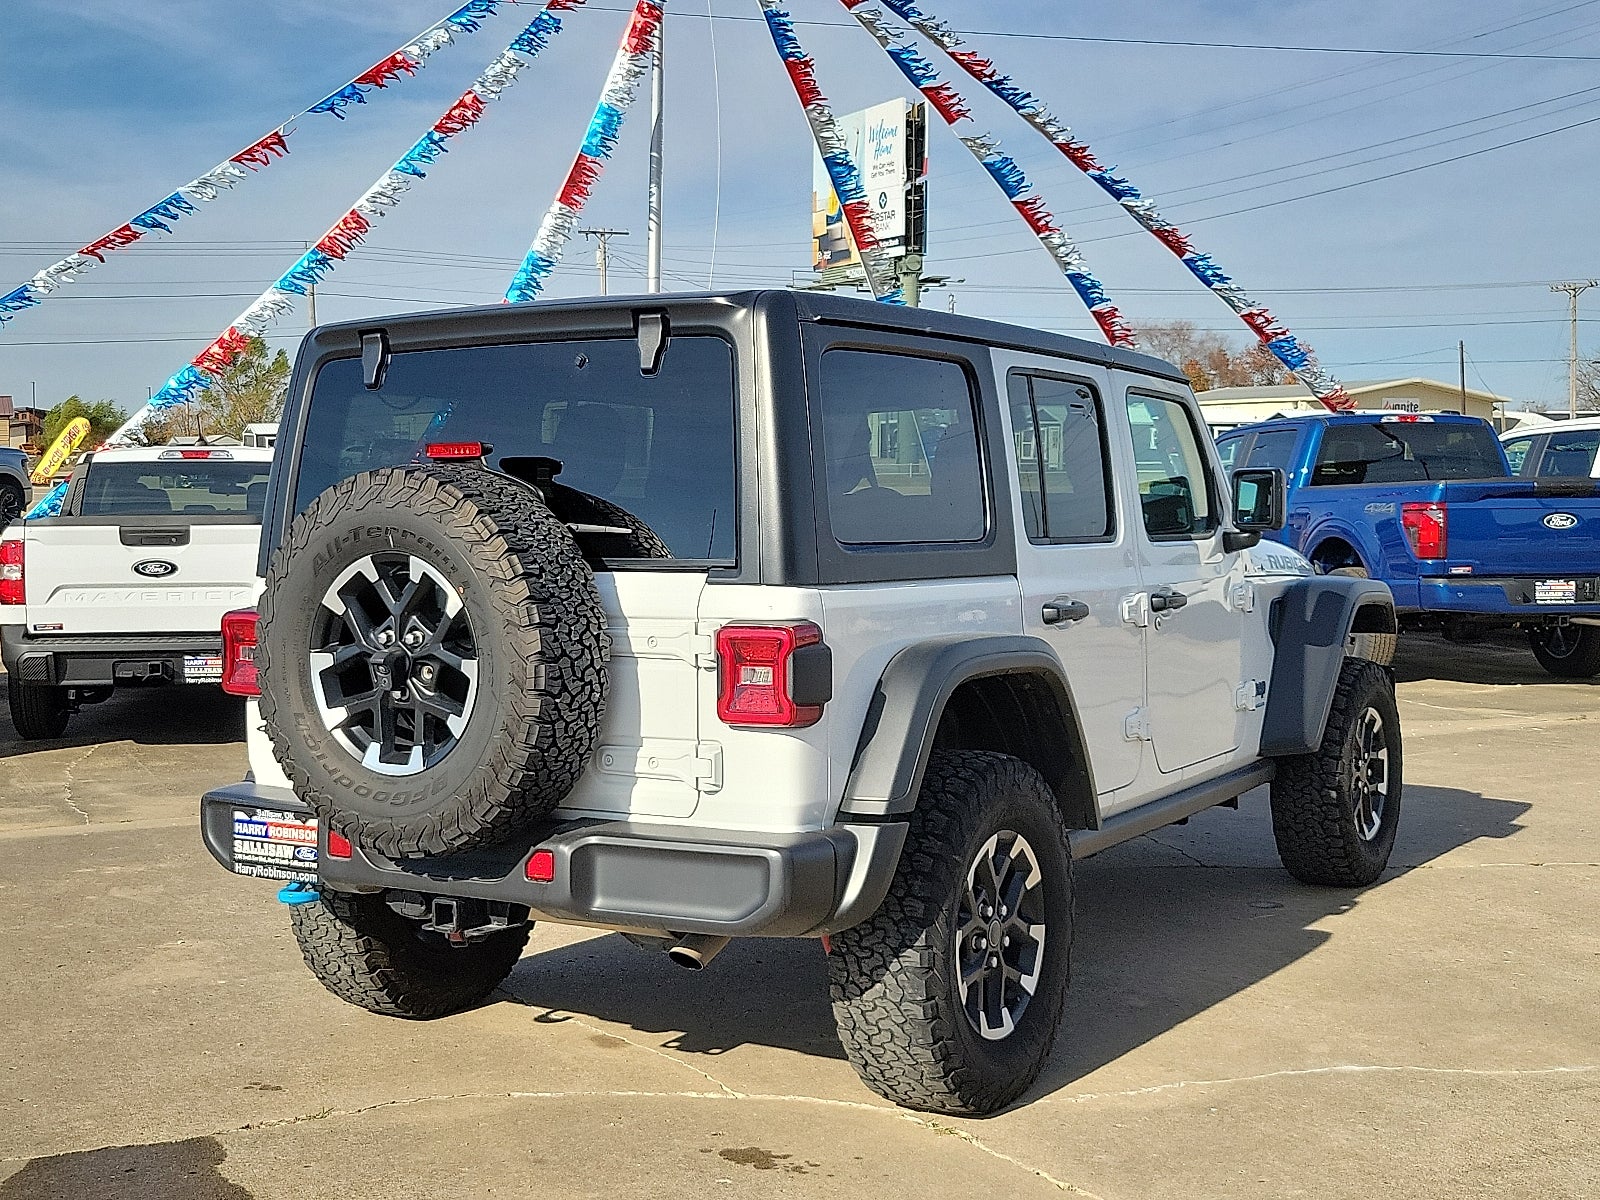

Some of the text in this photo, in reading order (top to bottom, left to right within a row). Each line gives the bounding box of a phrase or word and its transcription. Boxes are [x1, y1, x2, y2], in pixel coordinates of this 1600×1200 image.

[869, 118, 899, 144] Welcome
[874, 142, 893, 160] Home
[886, 160, 895, 168] Help
[870, 171, 878, 179] Get
[875, 222, 890, 233] BANK
[31, 473, 51, 485] HERE
[1549, 514, 1572, 526] Ford
[64, 591, 247, 601] MAVERICK
[283, 811, 296, 820] OK
[235, 822, 318, 841] HARRY ROBINSON
[233, 840, 317, 860] SALLISAW Ford
[234, 862, 318, 883] HarryRobinson.com
